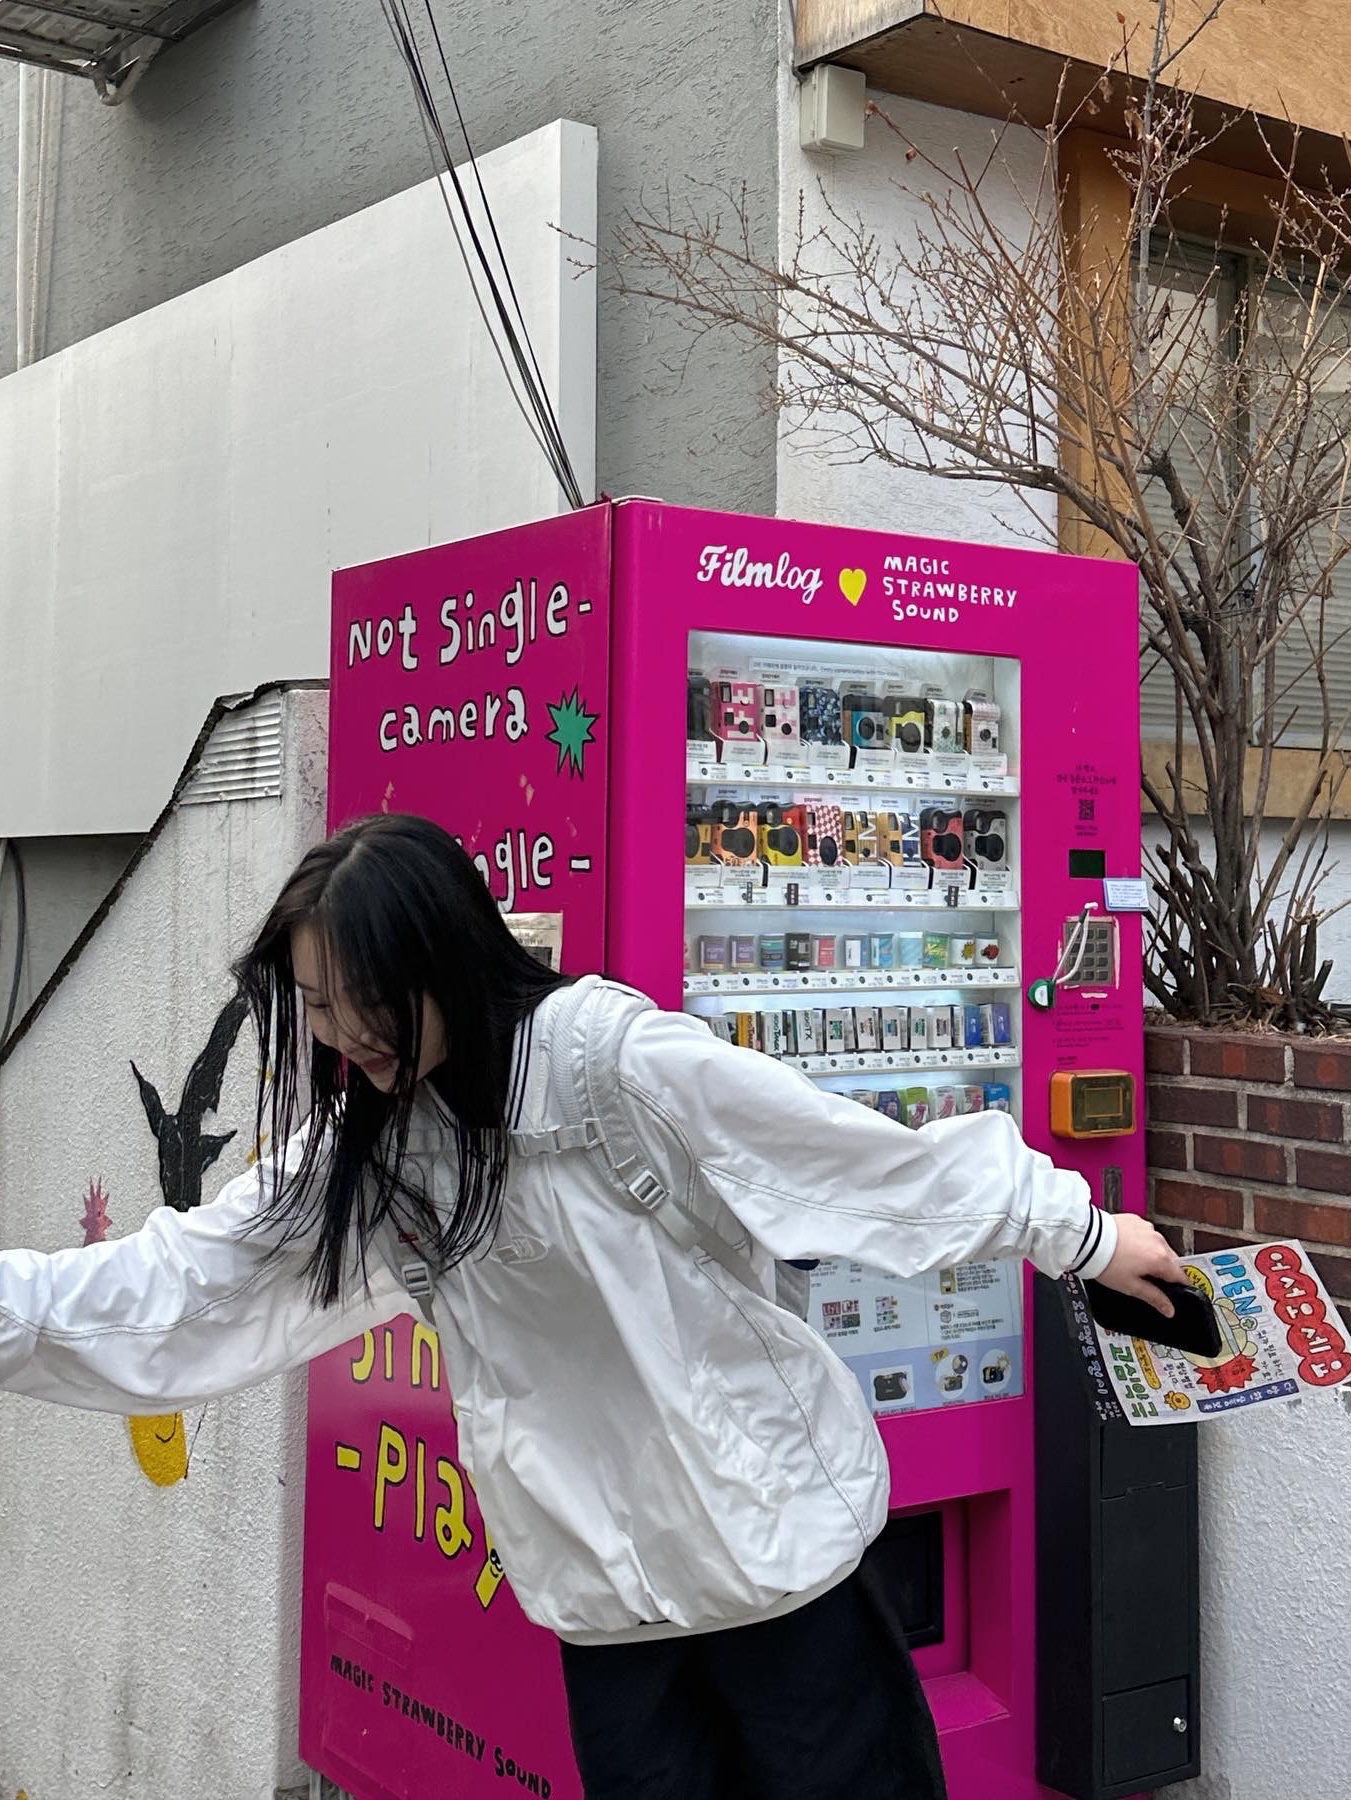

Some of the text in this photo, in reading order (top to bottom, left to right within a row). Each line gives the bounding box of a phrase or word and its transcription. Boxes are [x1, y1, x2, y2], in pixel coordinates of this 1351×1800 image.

[697, 545, 823, 604] Filmlog
[883, 577, 1017, 608] STRAWBERRY
[884, 556, 949, 575] MAGIC
[347, 603, 418, 671] Not
[892, 600, 959, 623] SOUND
[379, 687, 530, 752] camera
[1211, 1254, 1263, 1315] OPEN
[1268, 1251, 1343, 1378] 어서오세요
[1109, 1343, 1159, 1418] 고심약국
[330, 1653, 552, 1799] MAGIC STRAWBERRY SOUND
